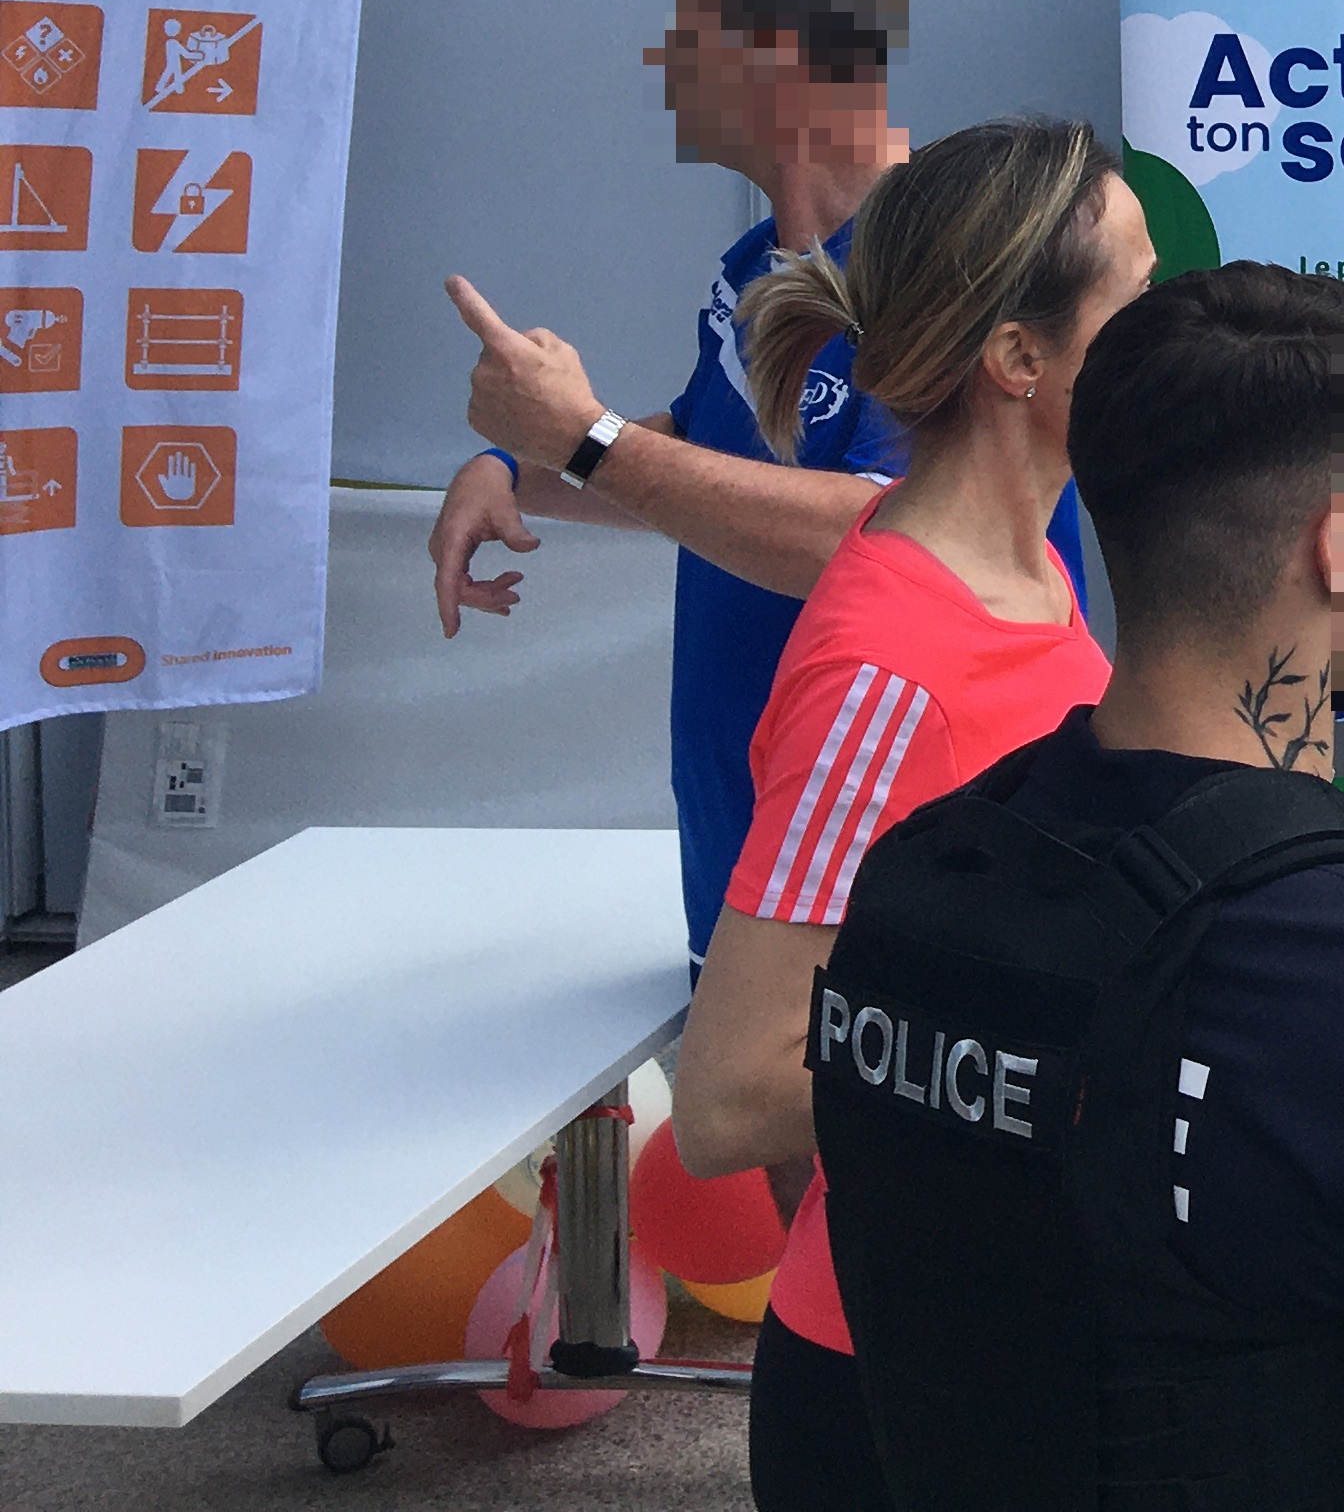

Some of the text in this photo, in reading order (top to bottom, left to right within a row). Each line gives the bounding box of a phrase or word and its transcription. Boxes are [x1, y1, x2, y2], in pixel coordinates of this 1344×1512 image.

[1186, 115, 1270, 152] ton
[161, 650, 210, 666] Shared
[820, 987, 1039, 1139] POLICE
